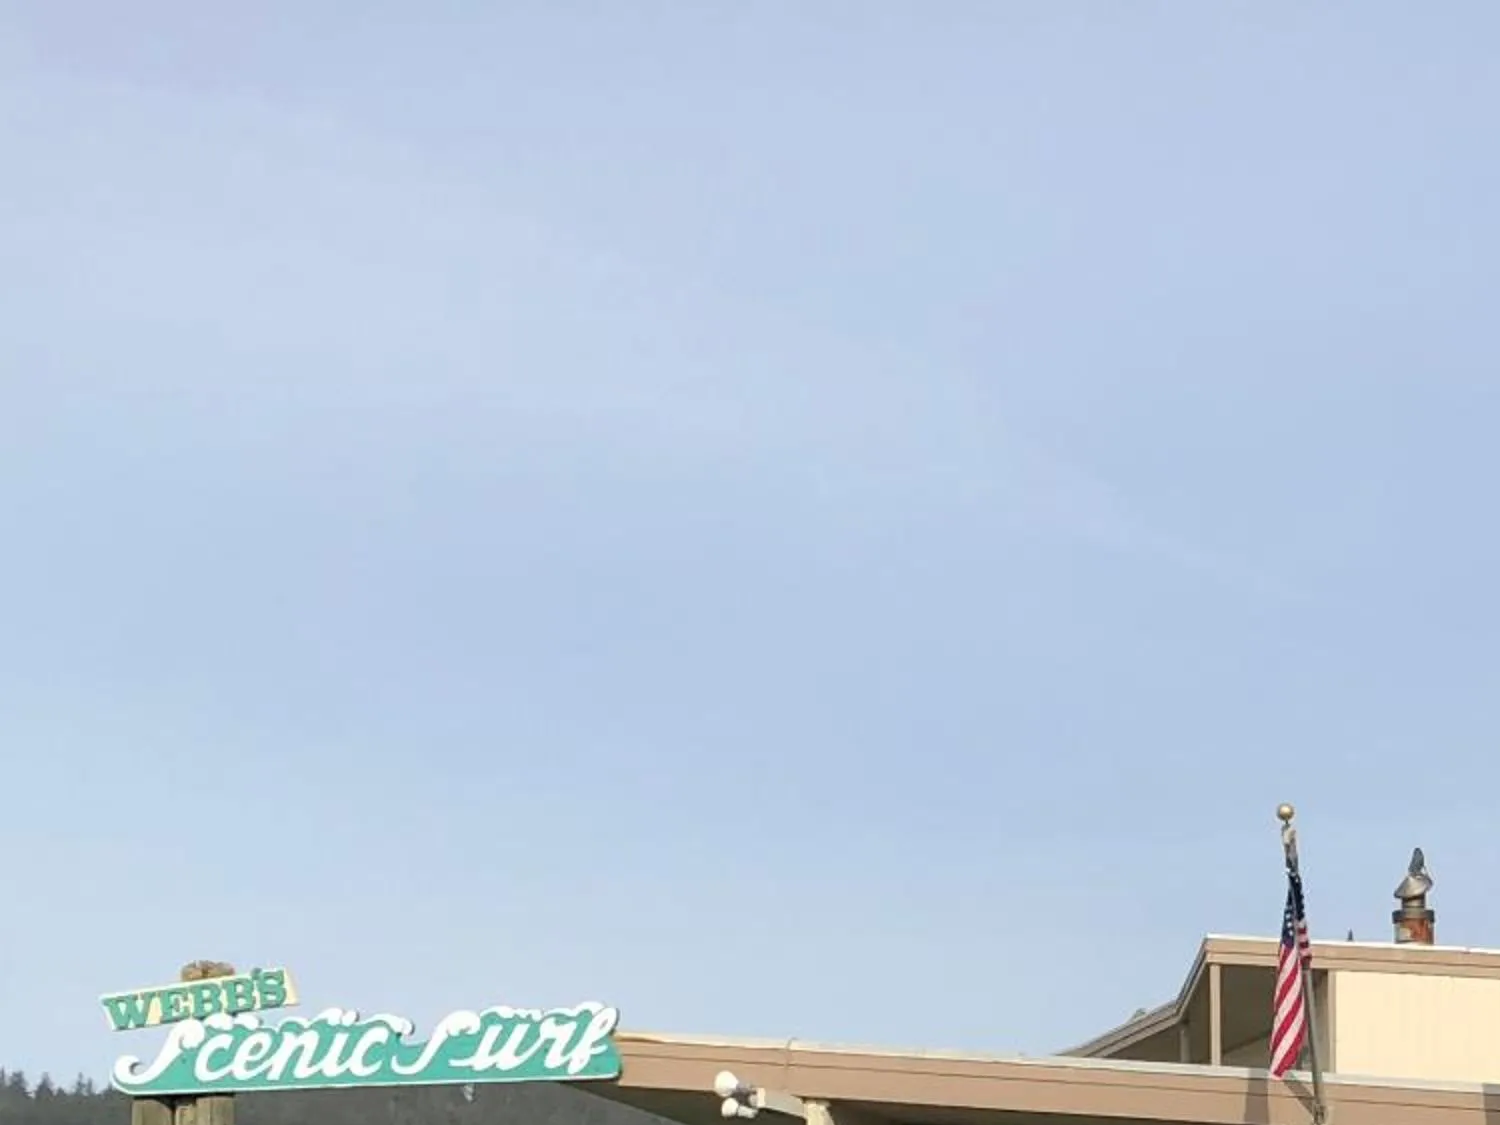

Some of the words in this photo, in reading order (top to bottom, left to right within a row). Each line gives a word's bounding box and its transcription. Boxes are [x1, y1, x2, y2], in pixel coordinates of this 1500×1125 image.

[101, 967, 288, 1031] WEBB'S
[114, 1009, 402, 1085] Scenic
[391, 1001, 619, 1077] Surf
